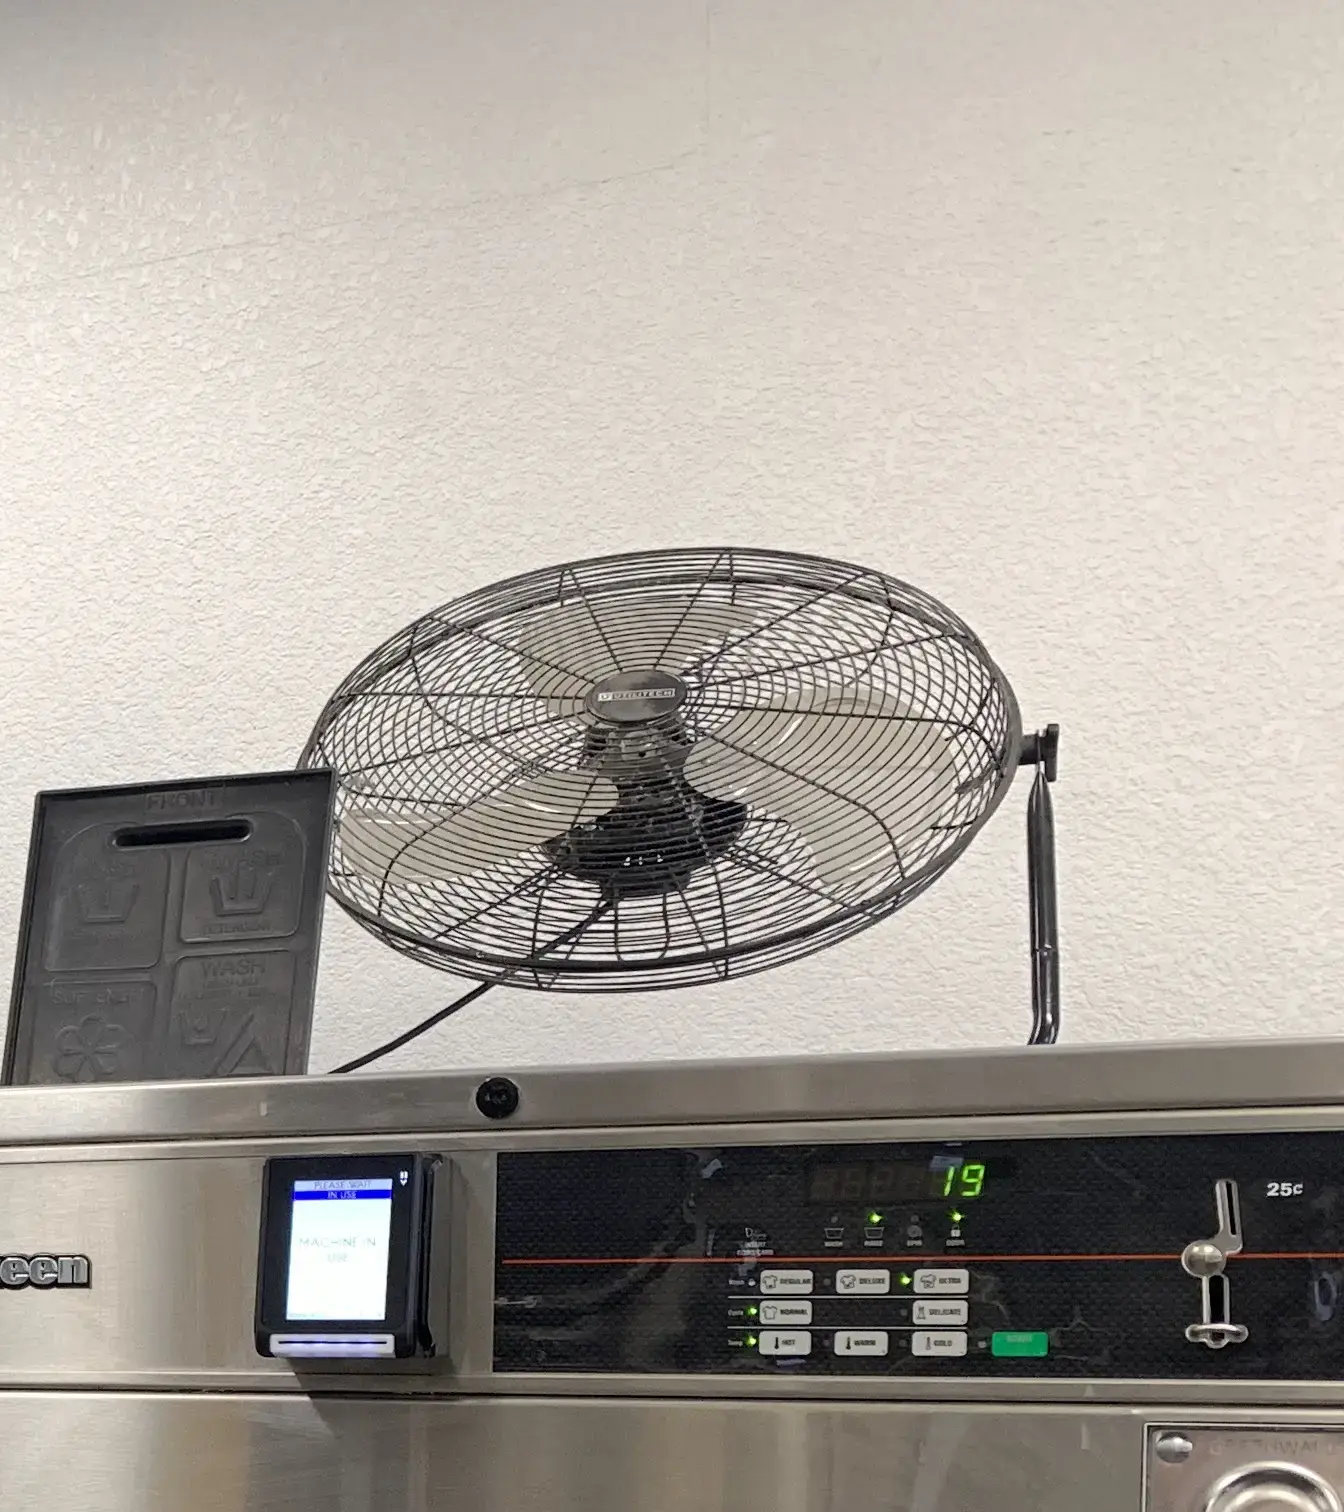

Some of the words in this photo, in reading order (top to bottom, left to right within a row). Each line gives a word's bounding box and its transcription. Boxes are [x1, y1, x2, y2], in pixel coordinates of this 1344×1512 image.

[314, 1181, 345, 1190] PLEASE
[350, 1180, 372, 1188] WAIT
[943, 1164, 986, 1197] 19
[327, 1191, 338, 1199] IN
[340, 1191, 357, 1199] USE
[299, 1237, 357, 1248] MACHINE
